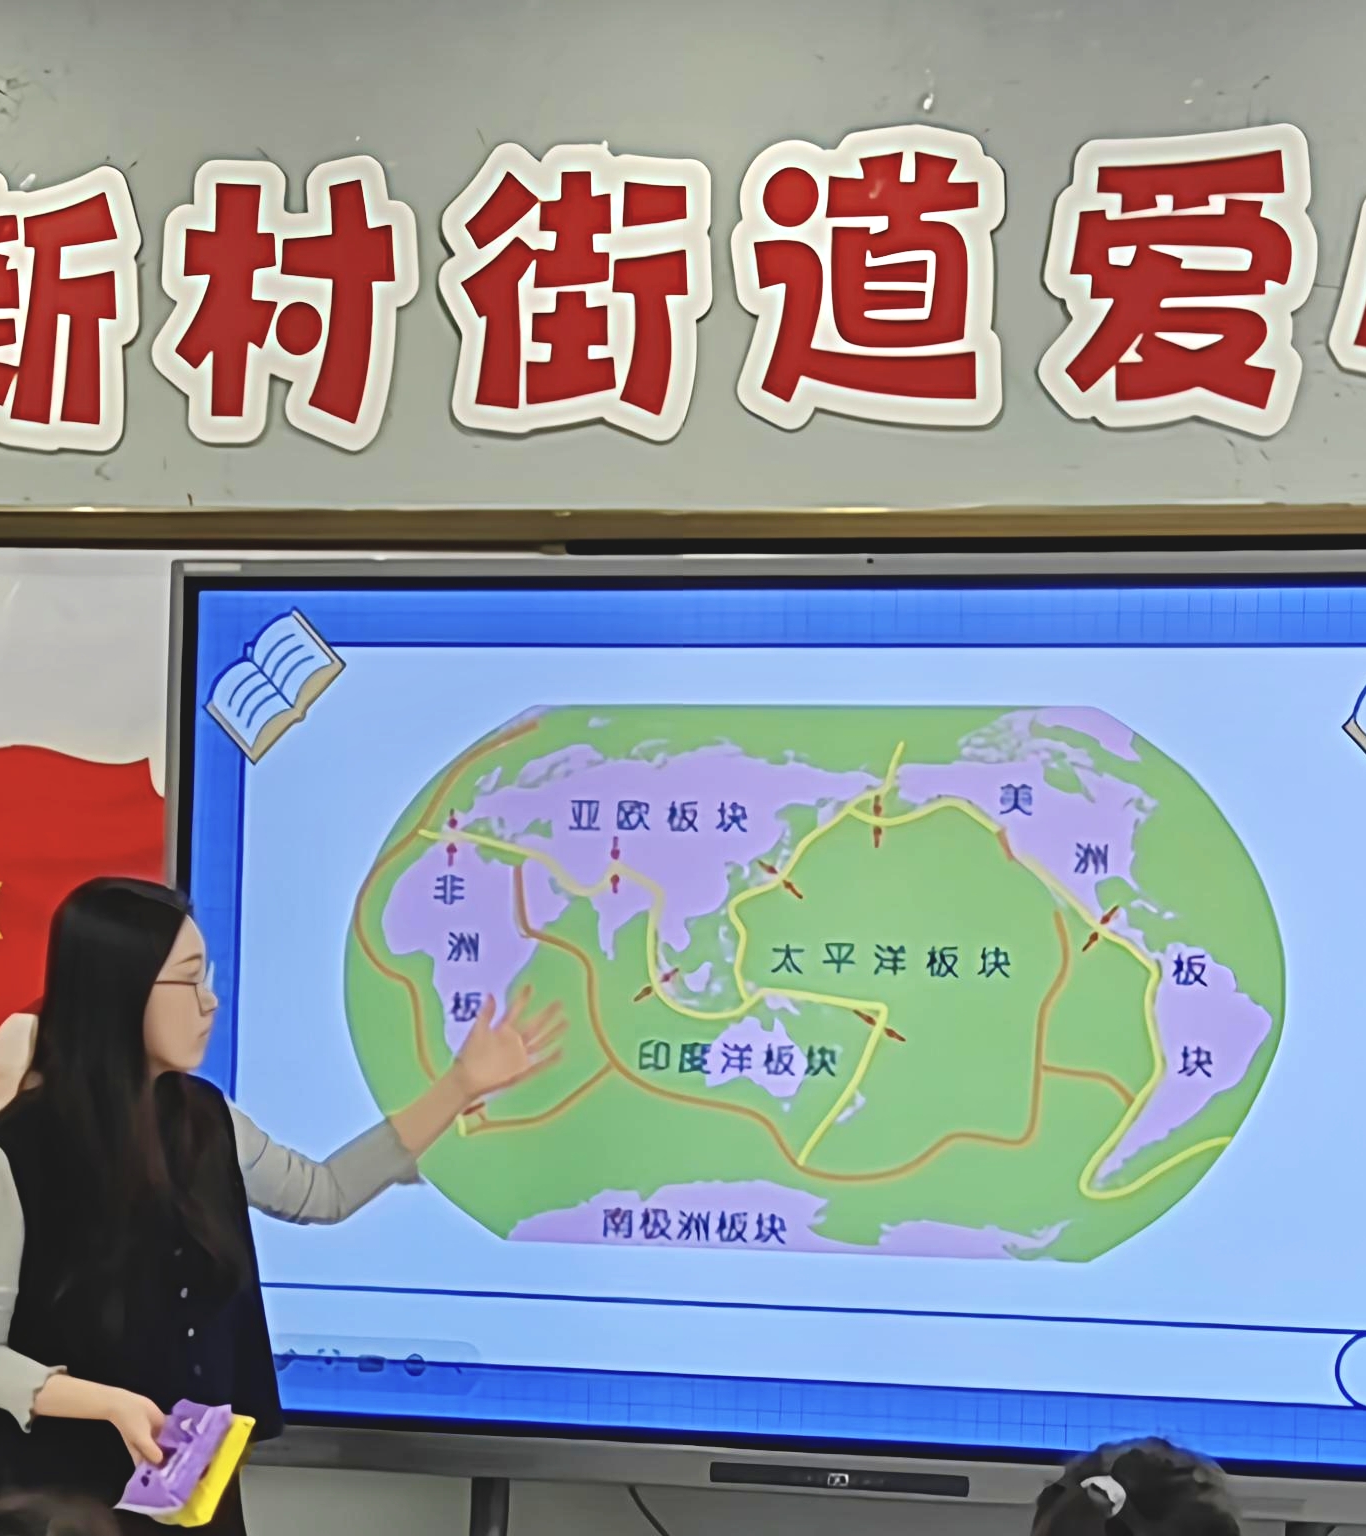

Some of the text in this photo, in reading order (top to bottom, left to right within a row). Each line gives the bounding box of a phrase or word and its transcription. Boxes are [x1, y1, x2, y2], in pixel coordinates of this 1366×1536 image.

[568, 799, 748, 835] 亚欧板块
[432, 874, 482, 1023] 非洲板
[771, 942, 1011, 979] 太平洋板块
[638, 1038, 838, 1078] 印度洋板块
[602, 1207, 788, 1245] 南极洲板块
